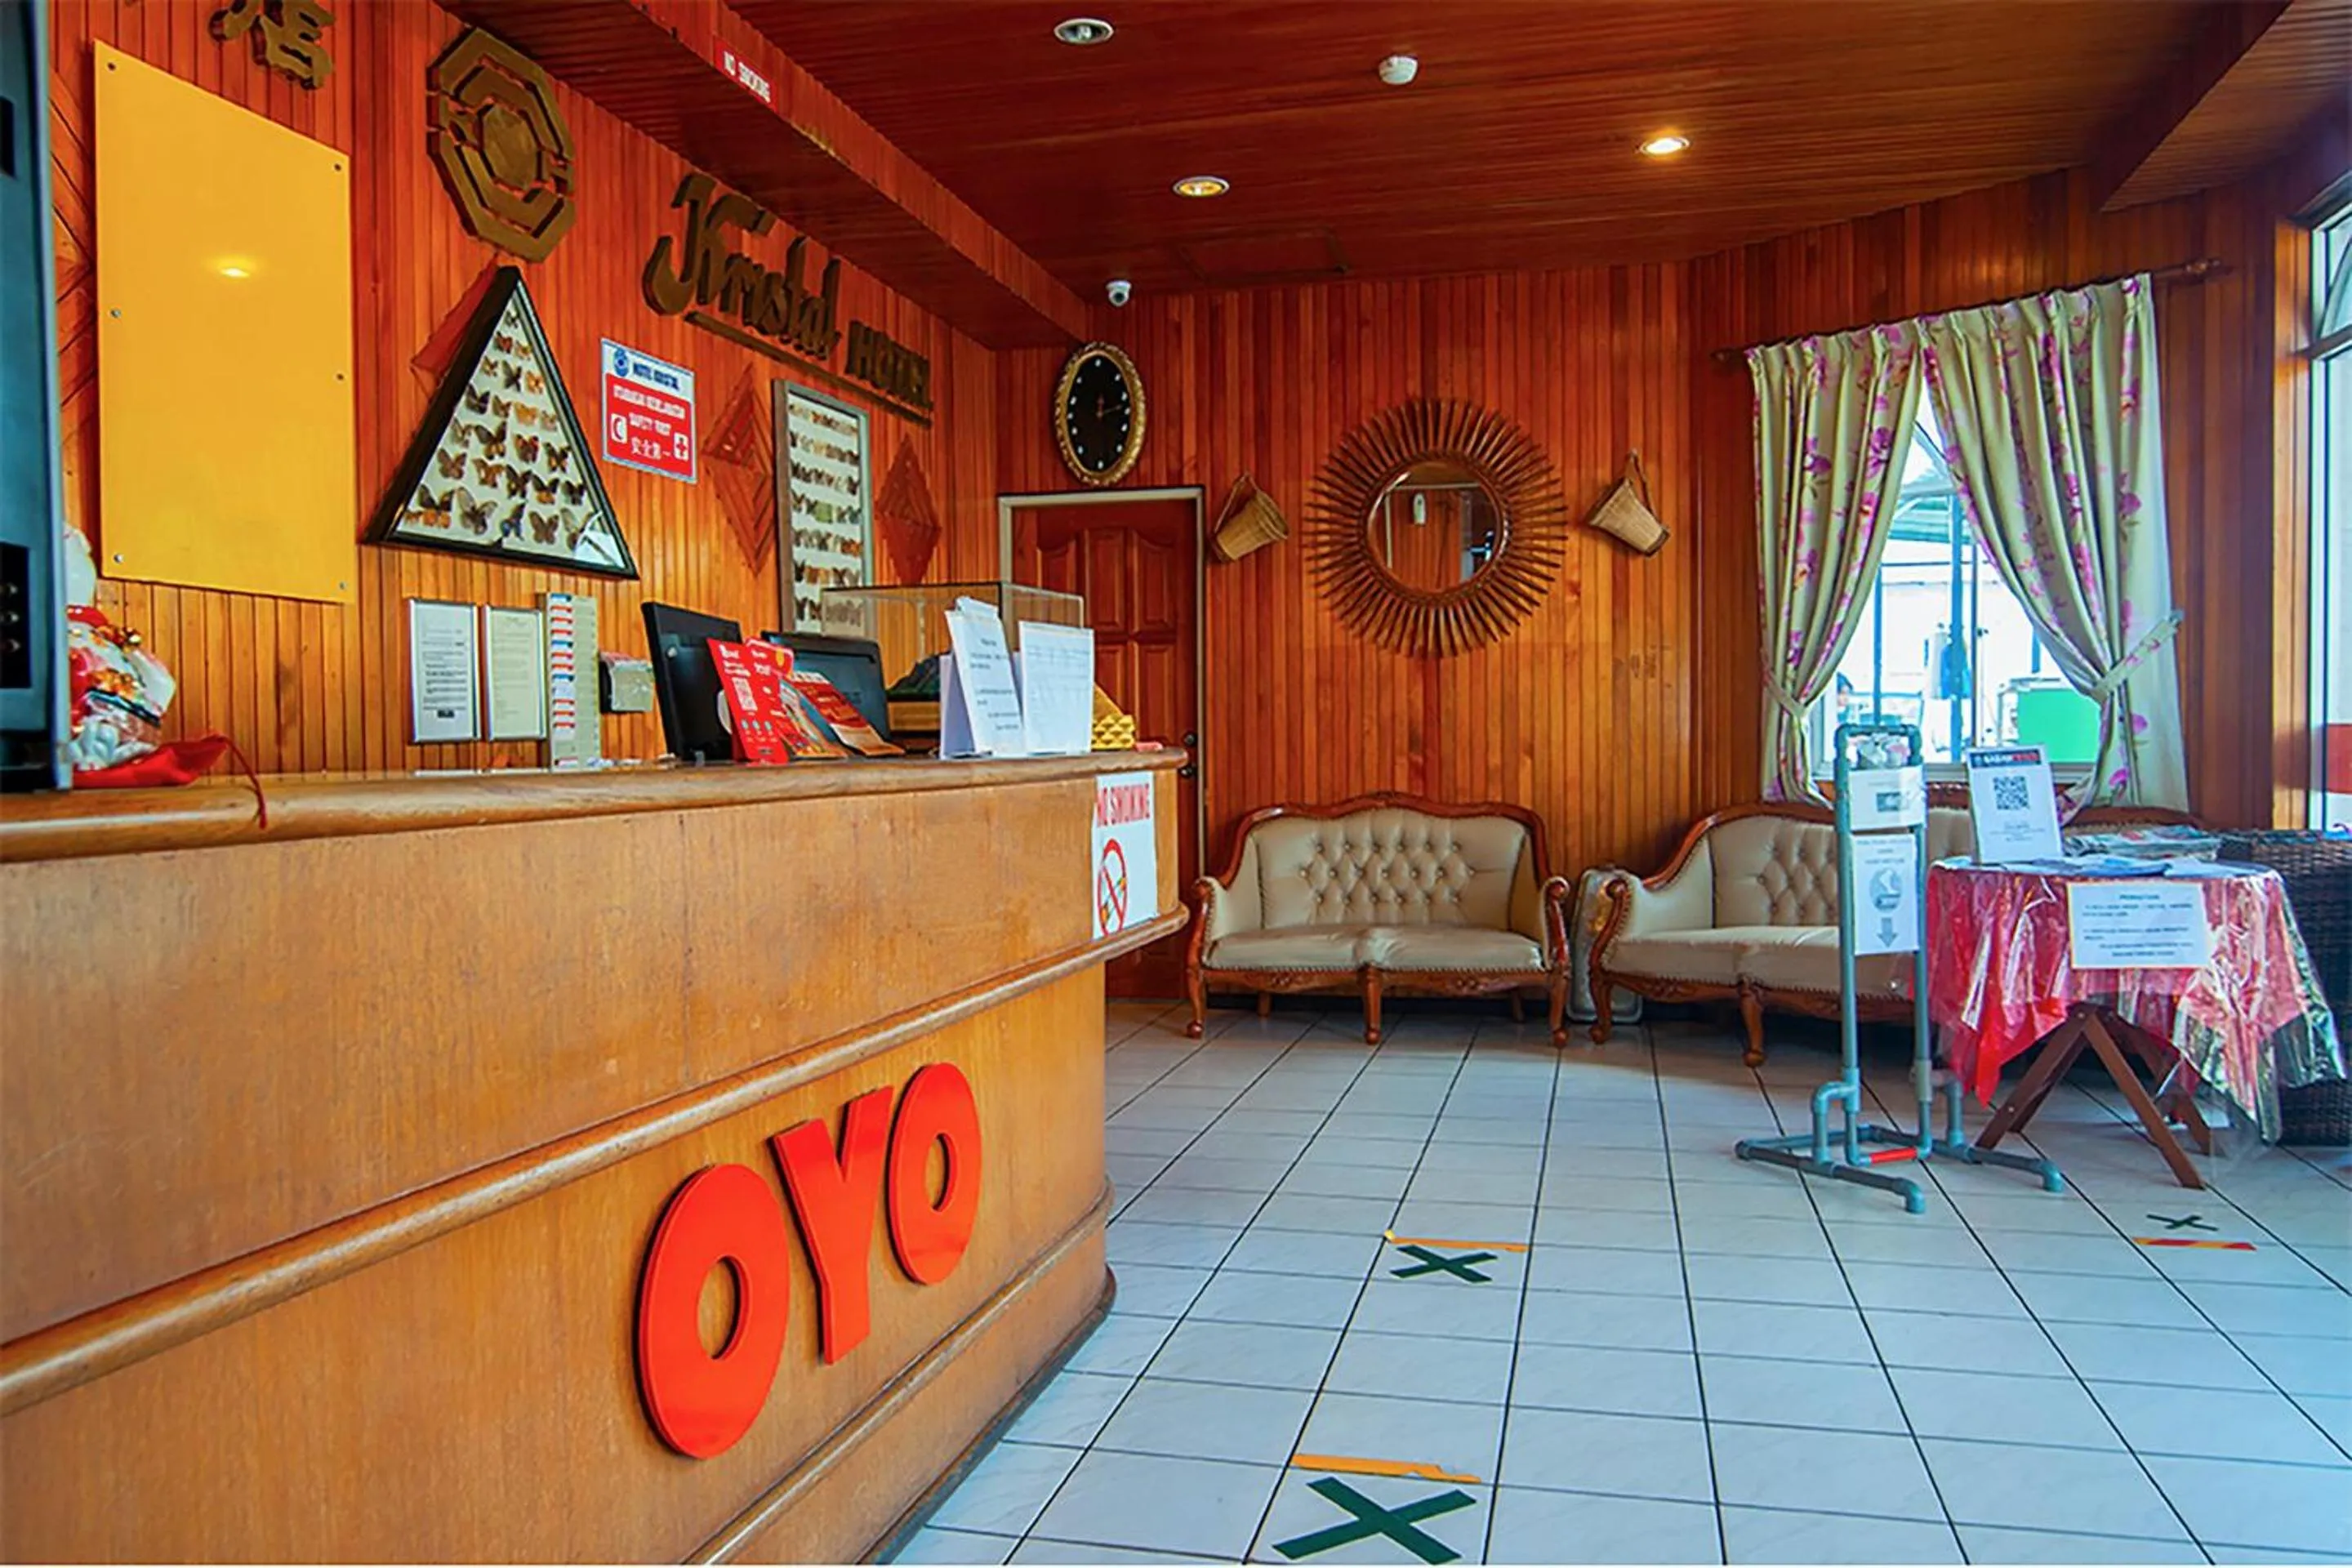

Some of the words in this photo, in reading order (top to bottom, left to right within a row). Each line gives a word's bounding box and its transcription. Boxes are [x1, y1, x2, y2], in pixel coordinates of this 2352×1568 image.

[724, 51, 735, 76] NO
[738, 61, 771, 104] SMOKING
[1111, 782, 1151, 824] SMOKING
[635, 1062, 982, 1459] OYO
